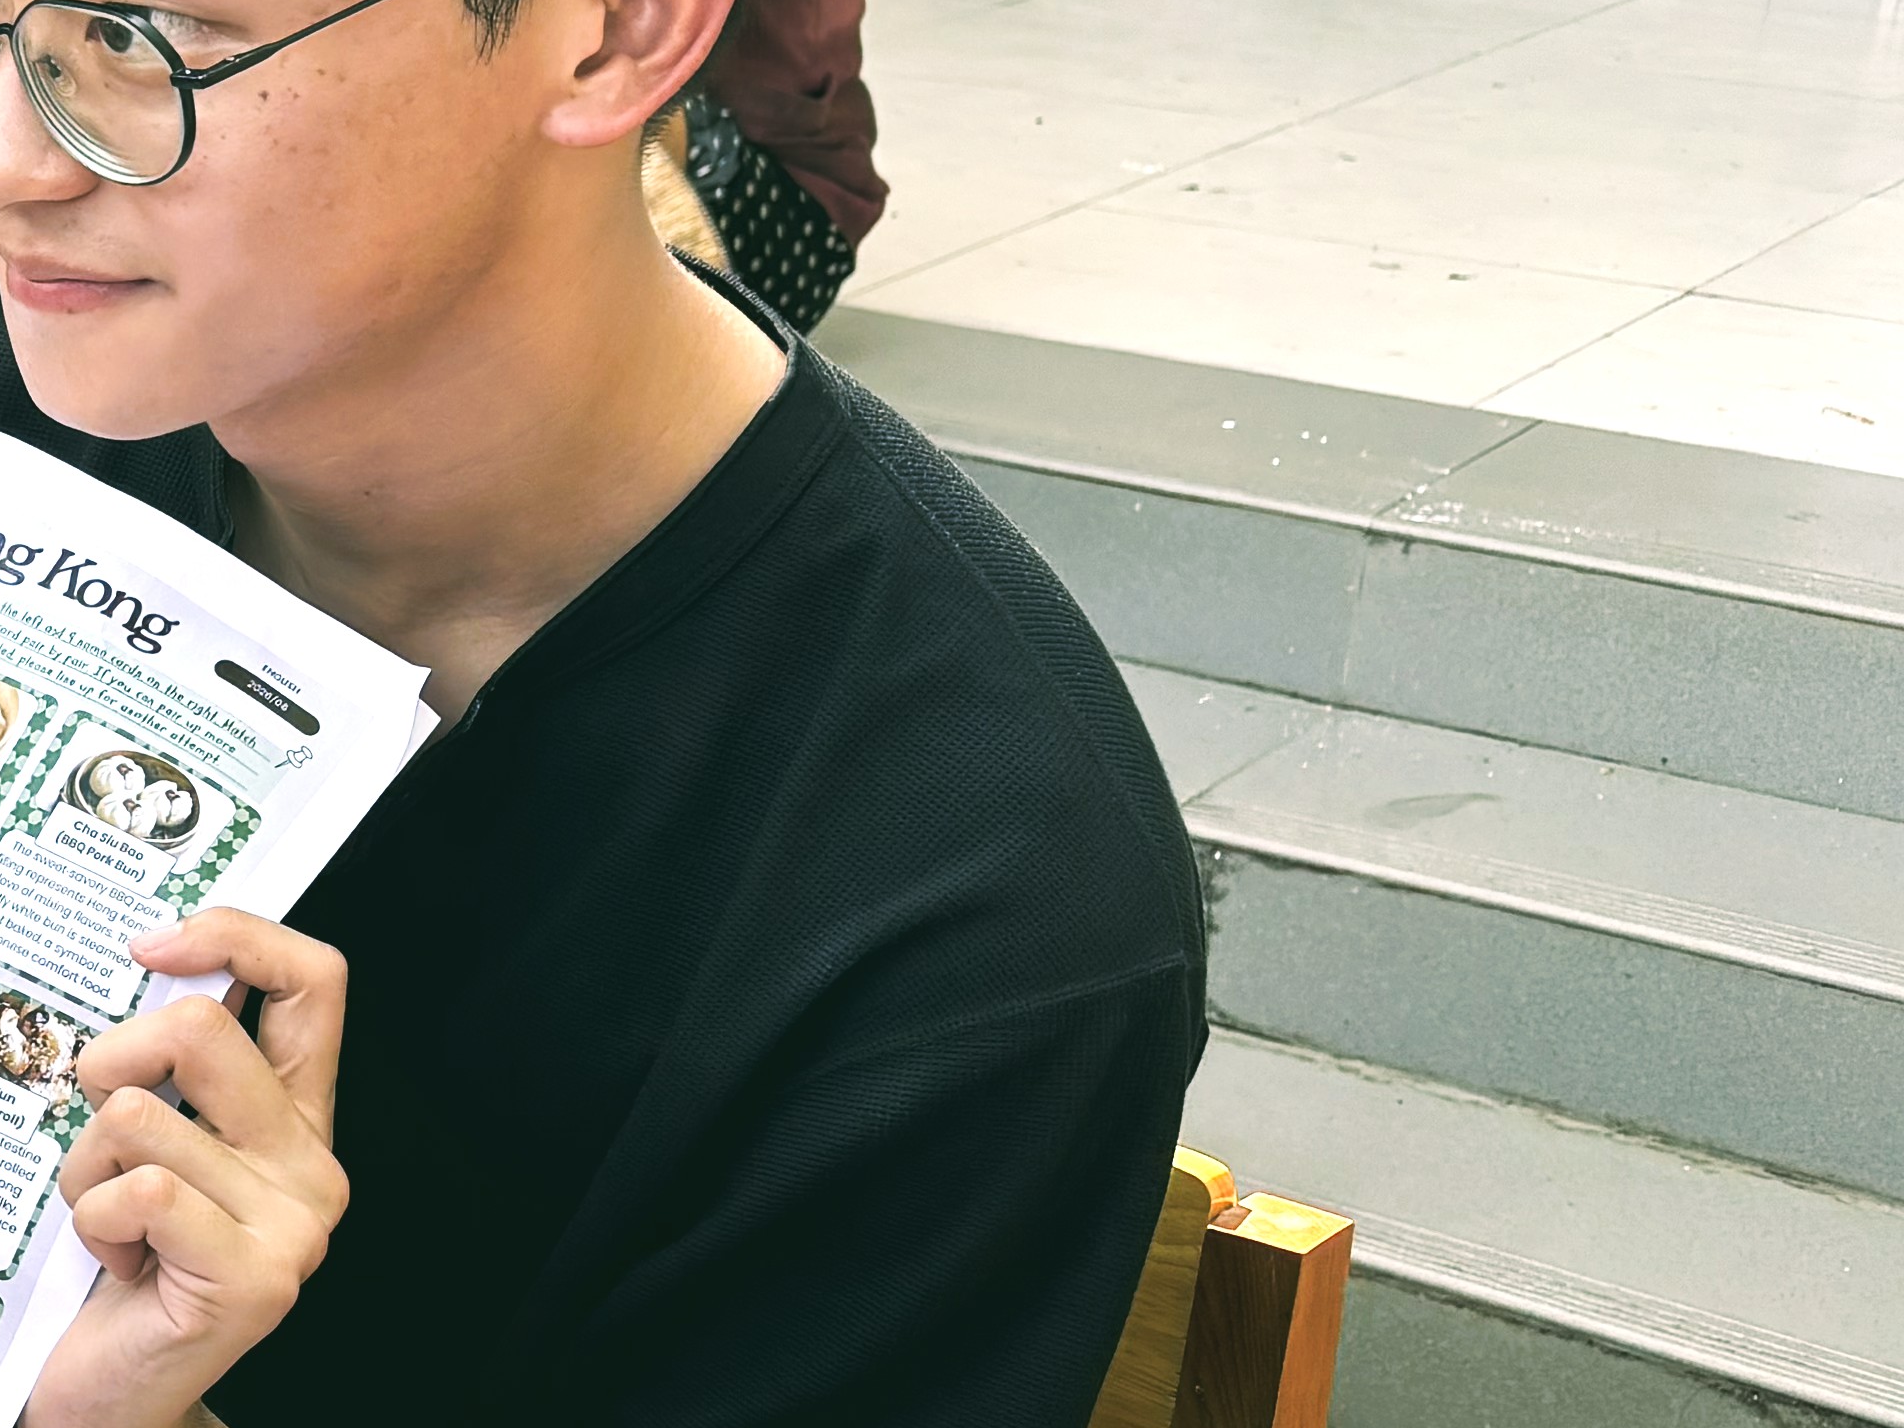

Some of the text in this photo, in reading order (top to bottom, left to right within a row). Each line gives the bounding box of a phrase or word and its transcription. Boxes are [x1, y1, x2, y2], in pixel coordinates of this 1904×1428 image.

[37, 548, 180, 654] Kong
[55, 830, 145, 882] (BBQ Pork Bun)
[73, 820, 143, 860] Cha Siu Bao
[31, 953, 78, 983] comfort
[80, 976, 114, 999] food.
[0, 1159, 36, 1181] rolled
